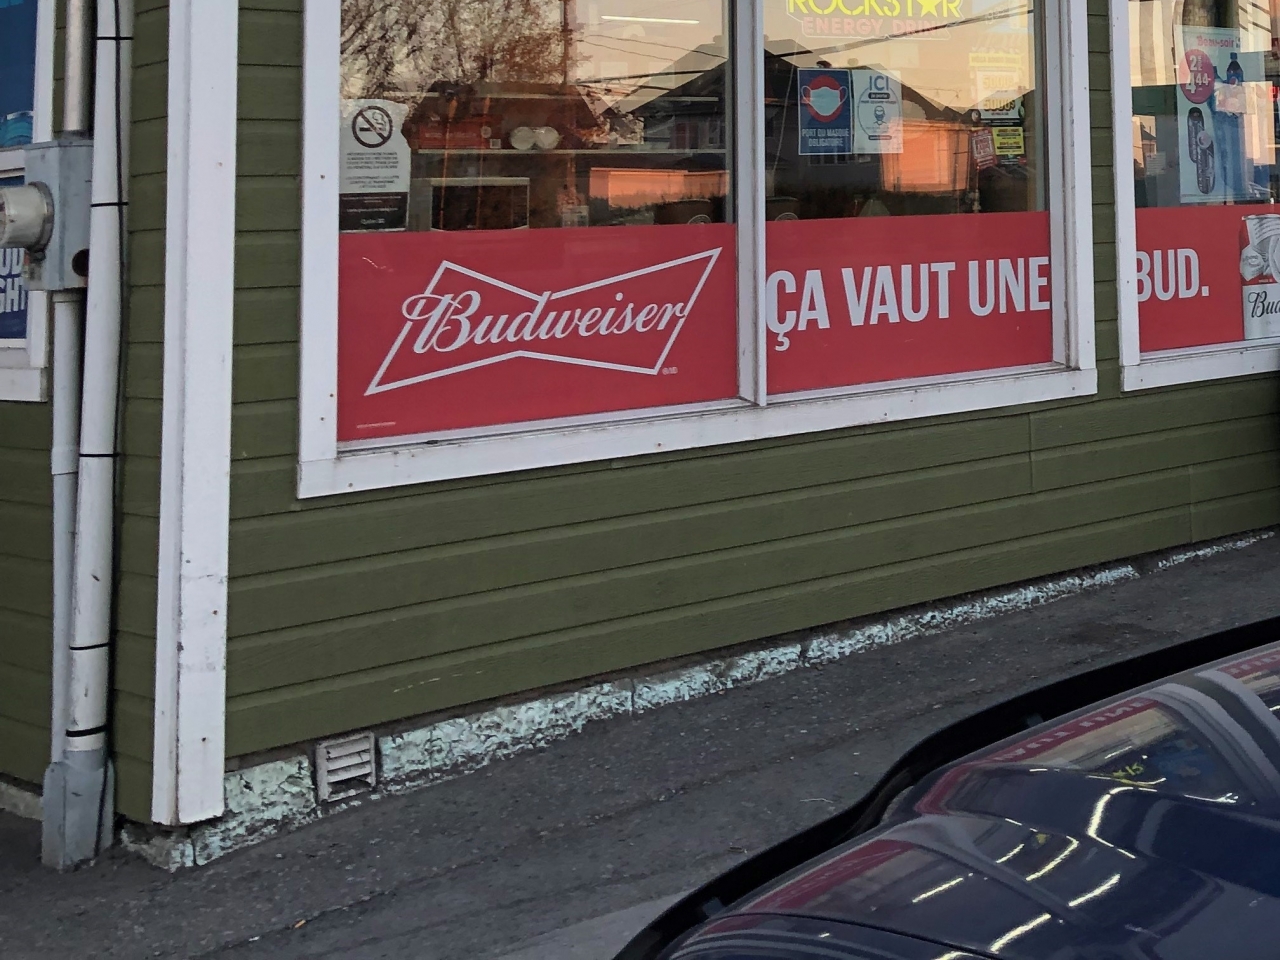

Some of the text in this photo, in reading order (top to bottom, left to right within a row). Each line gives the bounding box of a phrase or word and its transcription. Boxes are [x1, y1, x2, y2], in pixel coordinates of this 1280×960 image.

[803, 17, 884, 35] ENERGY
[869, 75, 889, 91] ICI
[801, 128, 850, 137] PORT DU MASQUE
[808, 138, 844, 147] OBLIGATOIRE
[766, 247, 1209, 351] ÇA VAUT UNE BUD.
[402, 291, 686, 354] Budweiser
